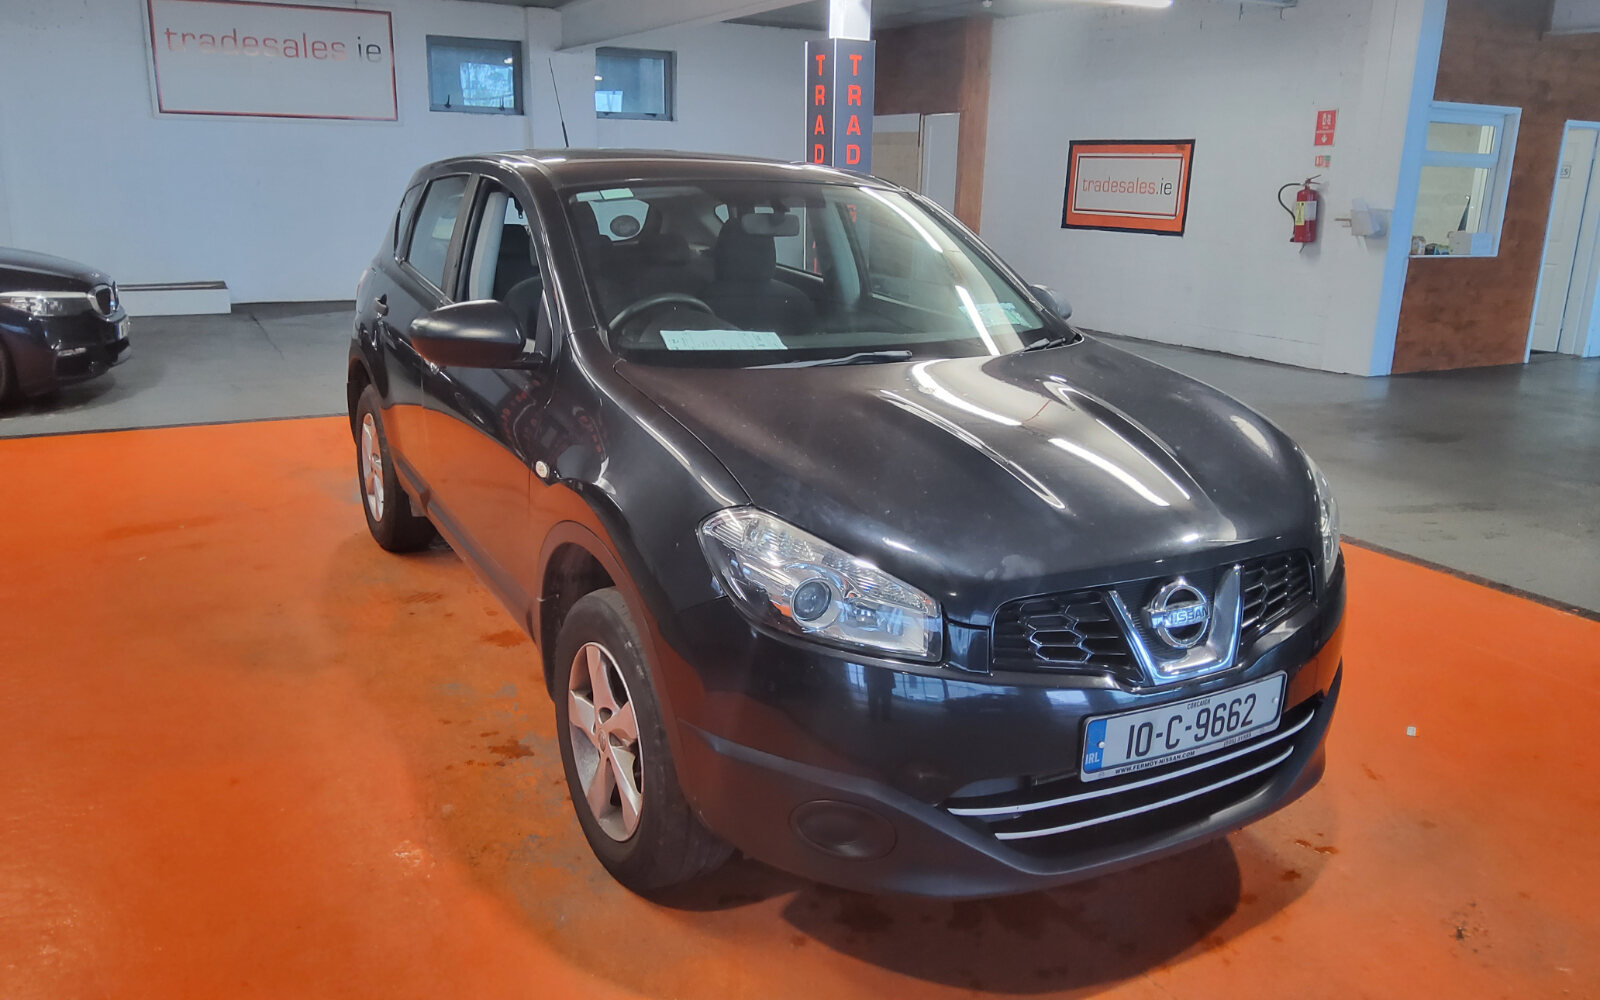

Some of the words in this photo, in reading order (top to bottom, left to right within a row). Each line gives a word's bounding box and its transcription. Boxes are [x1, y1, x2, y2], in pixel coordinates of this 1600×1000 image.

[1082, 176, 1173, 195] tradesales.ie
[1163, 605, 1209, 625] NISSAN
[1126, 693, 1257, 759] 10-C-9662
[1085, 752, 1100, 765] IRL
